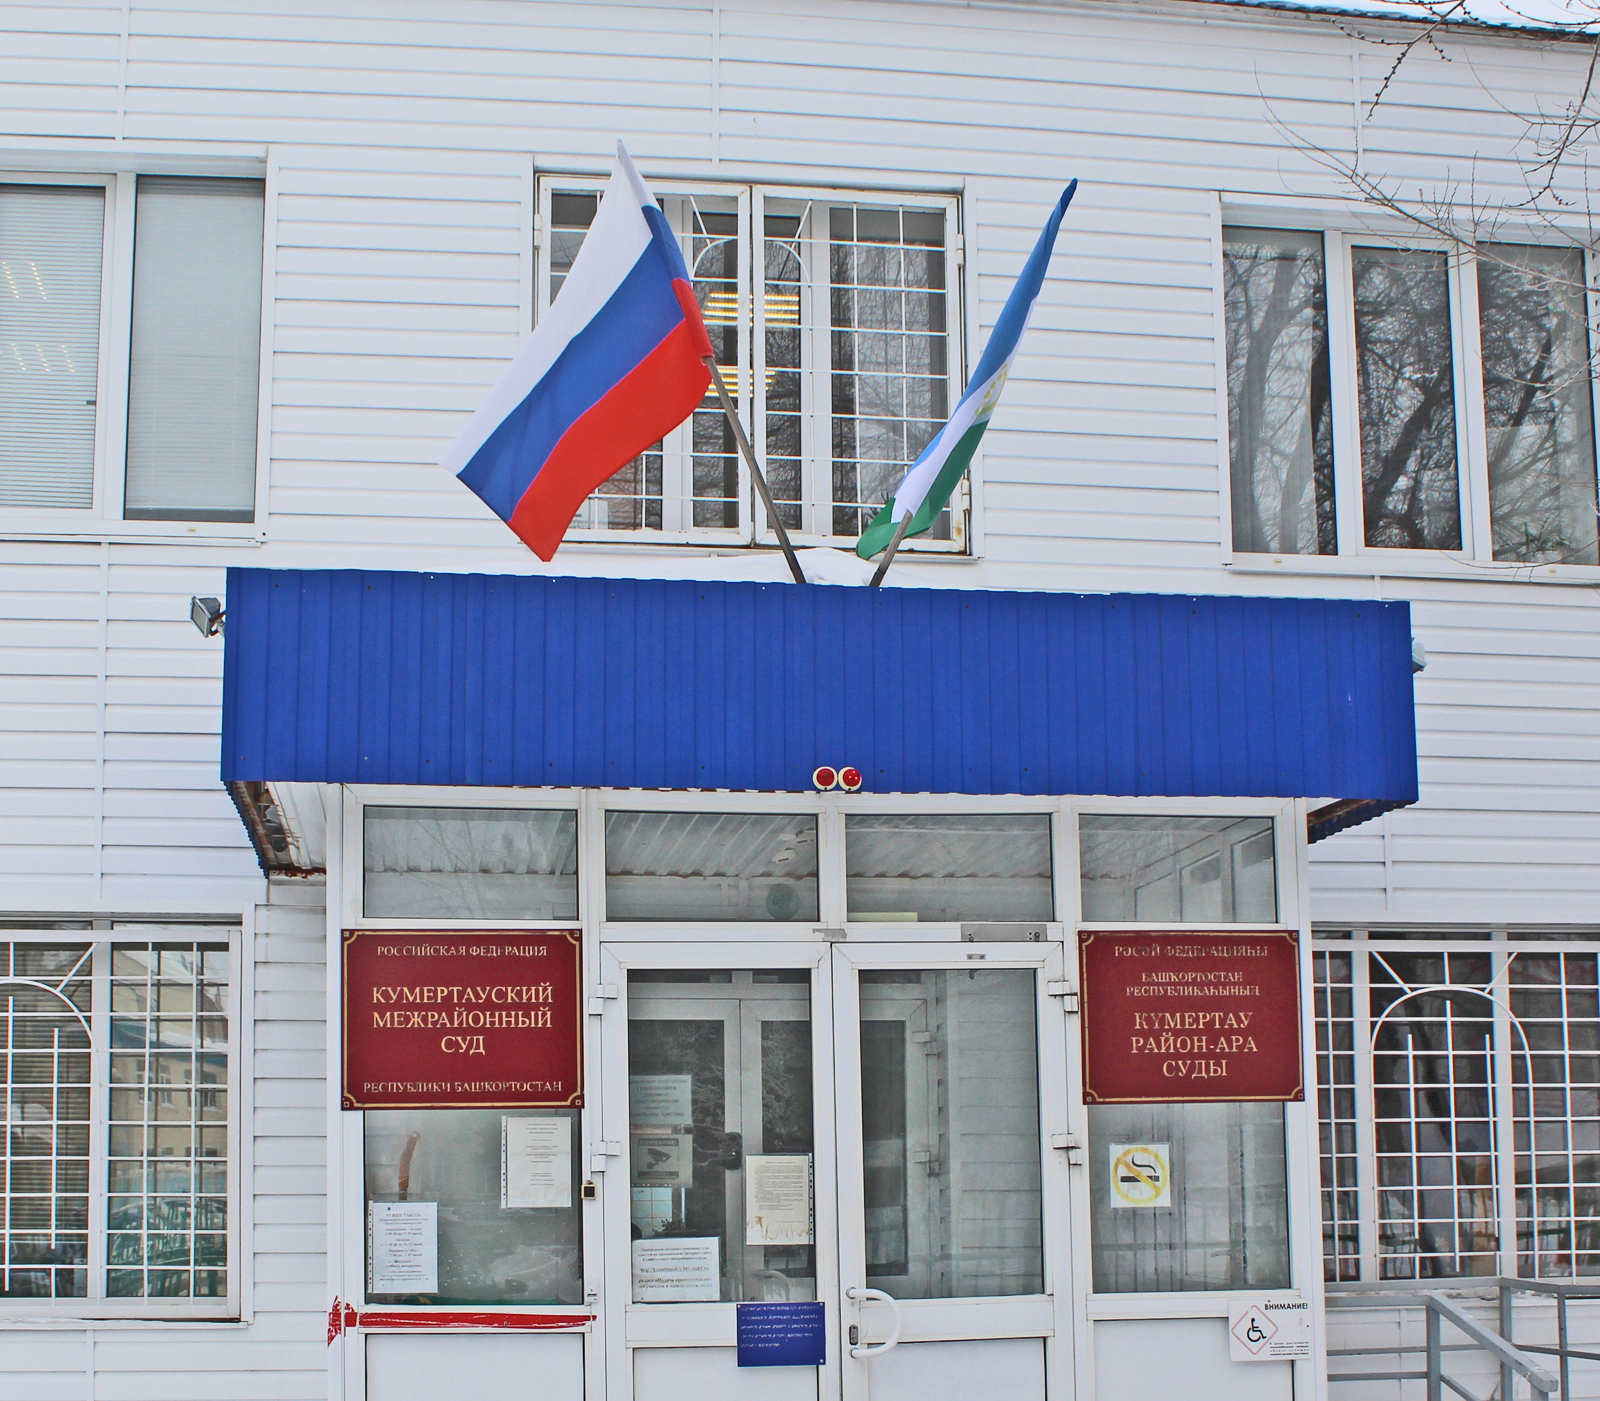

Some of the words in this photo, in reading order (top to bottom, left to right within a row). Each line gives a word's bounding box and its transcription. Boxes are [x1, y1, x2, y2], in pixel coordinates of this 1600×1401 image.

[377, 943, 466, 957] РОССИЙСКАЯ
[372, 981, 553, 1004] КУМЕРТАУСКИЙ
[372, 1006, 553, 1029] МЕЖРАЙОННЫЙ
[1134, 1011, 1254, 1030] КҮМЕРТАУ
[440, 1035, 486, 1056] СУД
[1131, 1031, 1259, 1054] РАЙОН-АРА
[1162, 1059, 1228, 1080] СУДЫ
[363, 1081, 451, 1093] РЕСПУБЛИКИ
[454, 1081, 562, 1093] БАШКОРТОСТАН
[1264, 1302, 1308, 1311] ВНИМАНИЕ!
